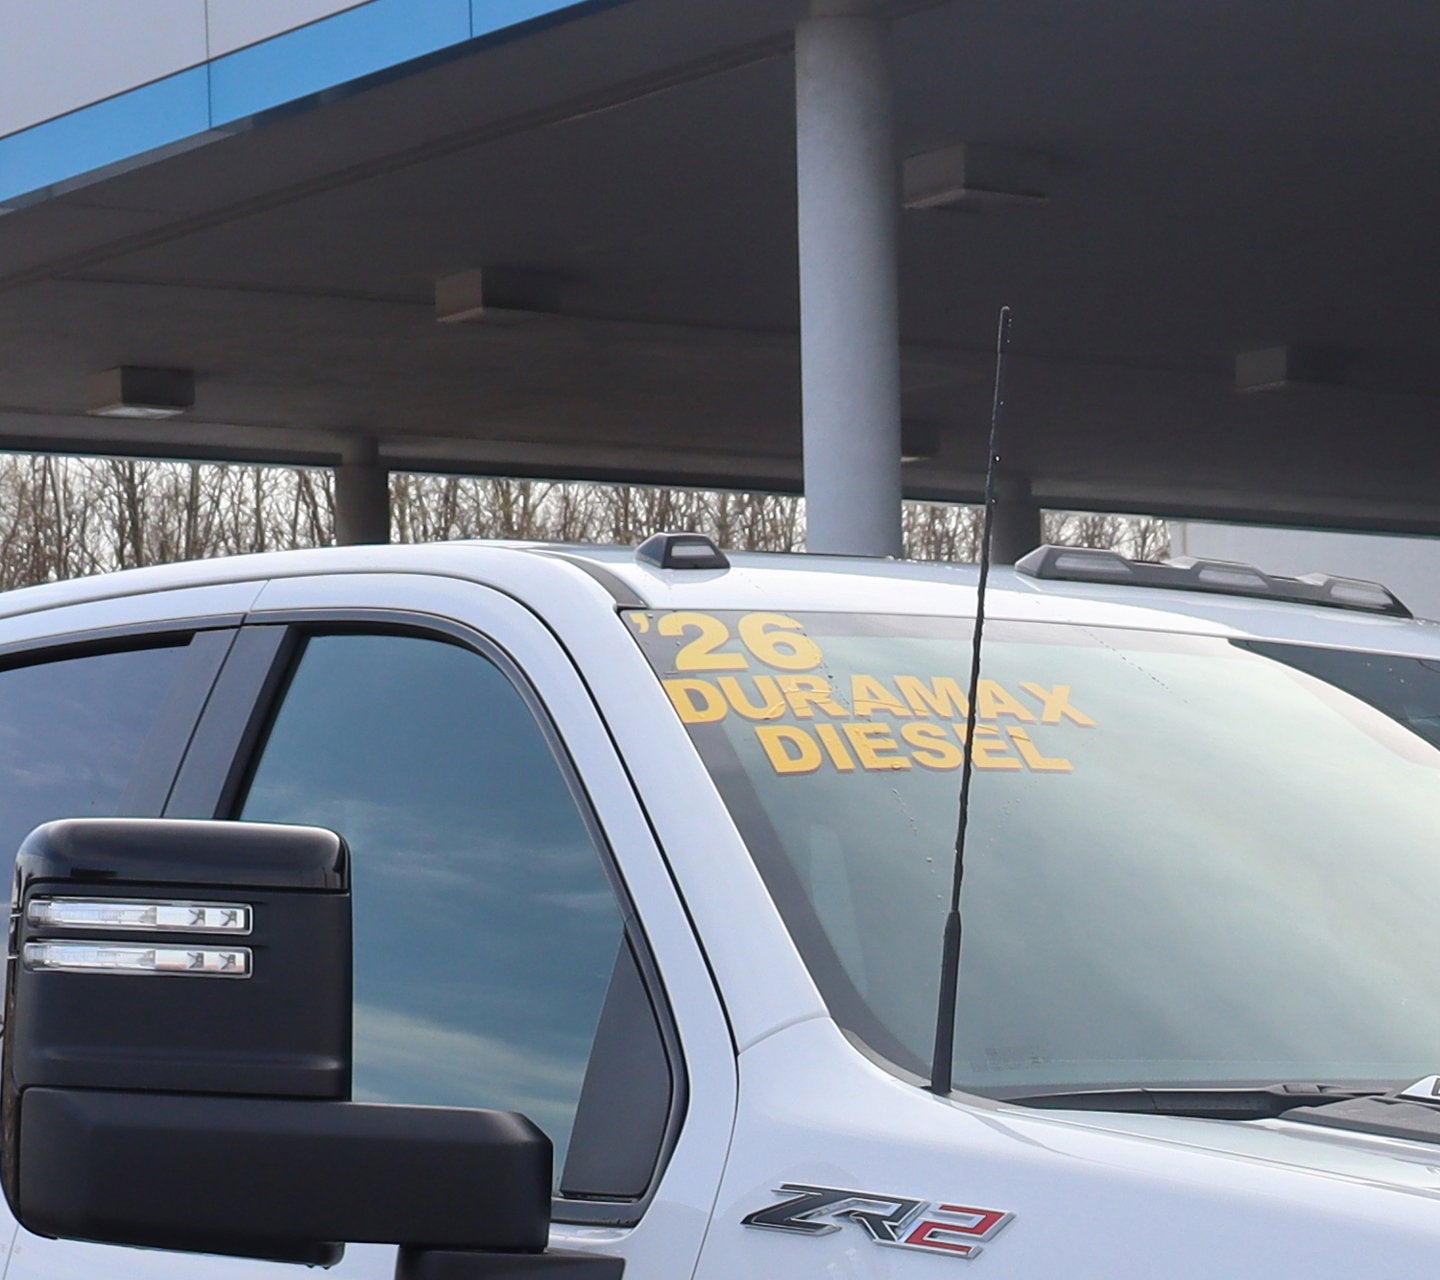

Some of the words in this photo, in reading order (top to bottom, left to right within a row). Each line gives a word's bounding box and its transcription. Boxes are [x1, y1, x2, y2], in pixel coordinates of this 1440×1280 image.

[662, 674, 1097, 726] DURAMAX
[755, 724, 1074, 773] DIESEL
[740, 1181, 1018, 1260] ZR2
